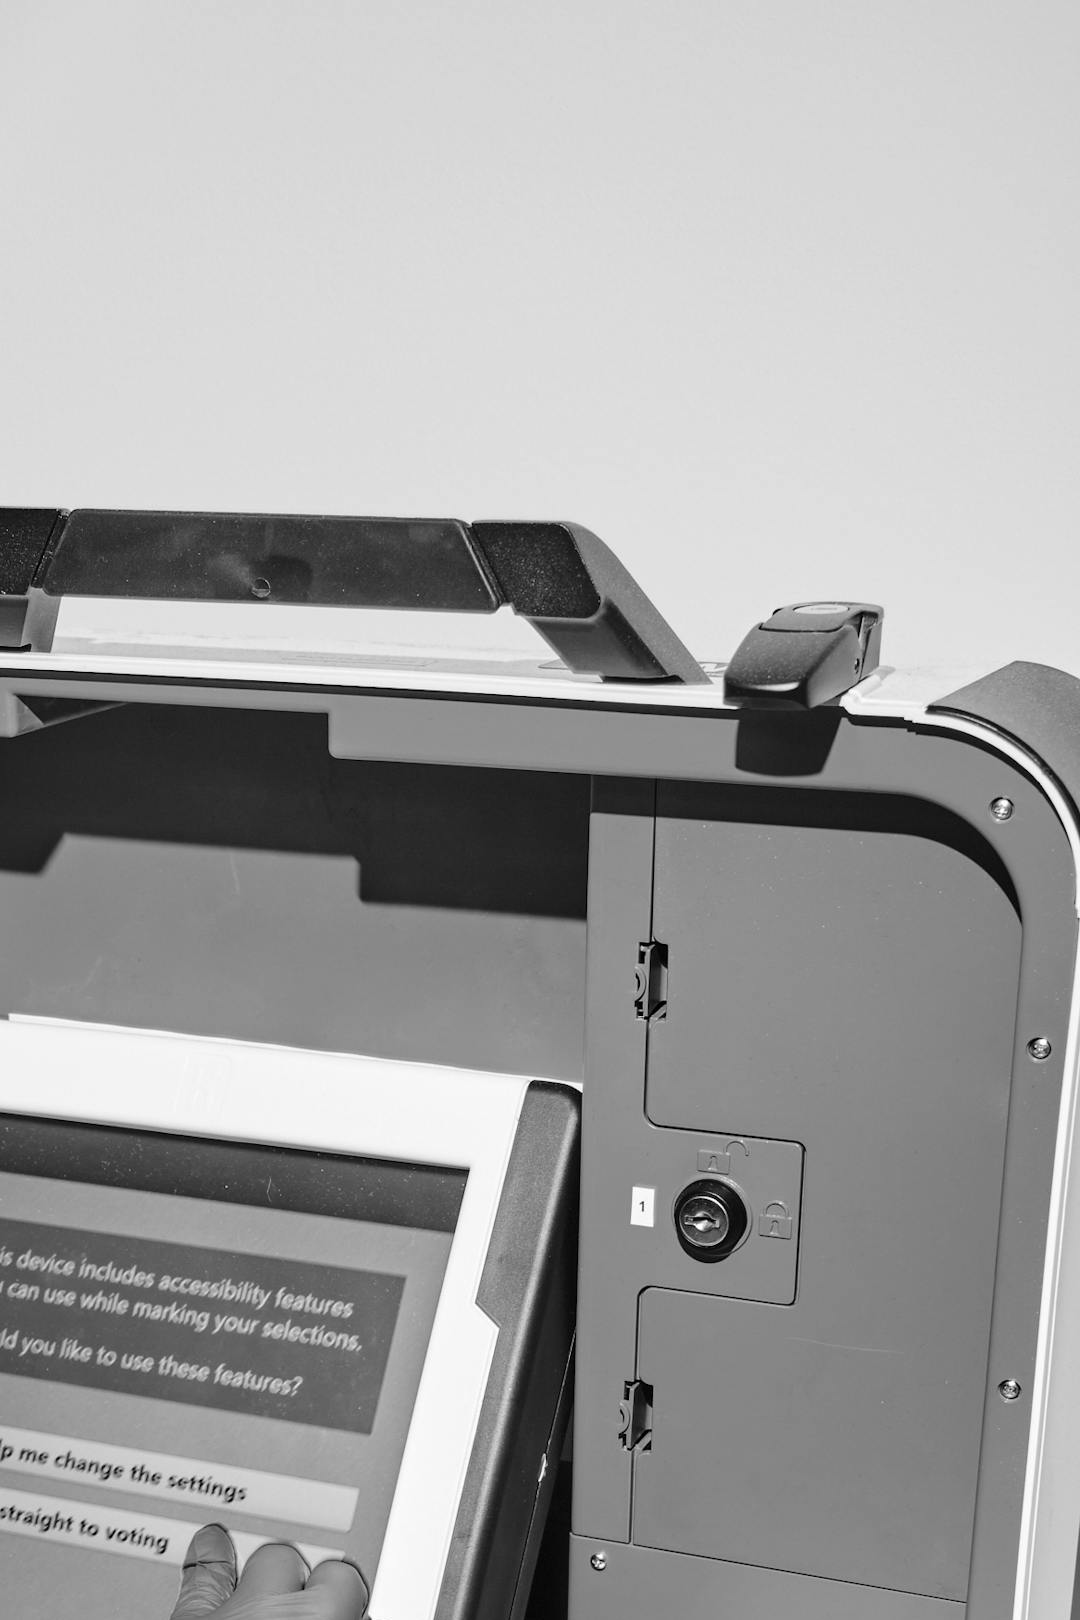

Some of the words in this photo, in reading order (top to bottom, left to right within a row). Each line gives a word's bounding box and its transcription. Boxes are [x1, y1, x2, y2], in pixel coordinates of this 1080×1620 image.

[639, 1200, 645, 1213] 1
[17, 1248, 74, 1276] device
[79, 1259, 154, 1288] includes
[158, 1275, 272, 1309] accessibility
[276, 1287, 353, 1317] features
[7, 1281, 39, 1302] can
[43, 1287, 75, 1308] use
[80, 1292, 128, 1315] while
[133, 1301, 209, 1333] marking
[212, 1312, 257, 1336] your
[262, 1318, 362, 1353] selections.
[20, 1334, 54, 1358] you
[59, 1337, 91, 1362] like
[96, 1346, 116, 1366] to
[121, 1349, 154, 1371] use
[159, 1355, 209, 1381] these
[213, 1364, 302, 1396] features?
[19, 1445, 49, 1465] me
[54, 1449, 124, 1480] change
[130, 1460, 162, 1485] the
[168, 1470, 247, 1503] settings
[79, 1518, 98, 1537] to
[104, 1523, 169, 1554] voting
